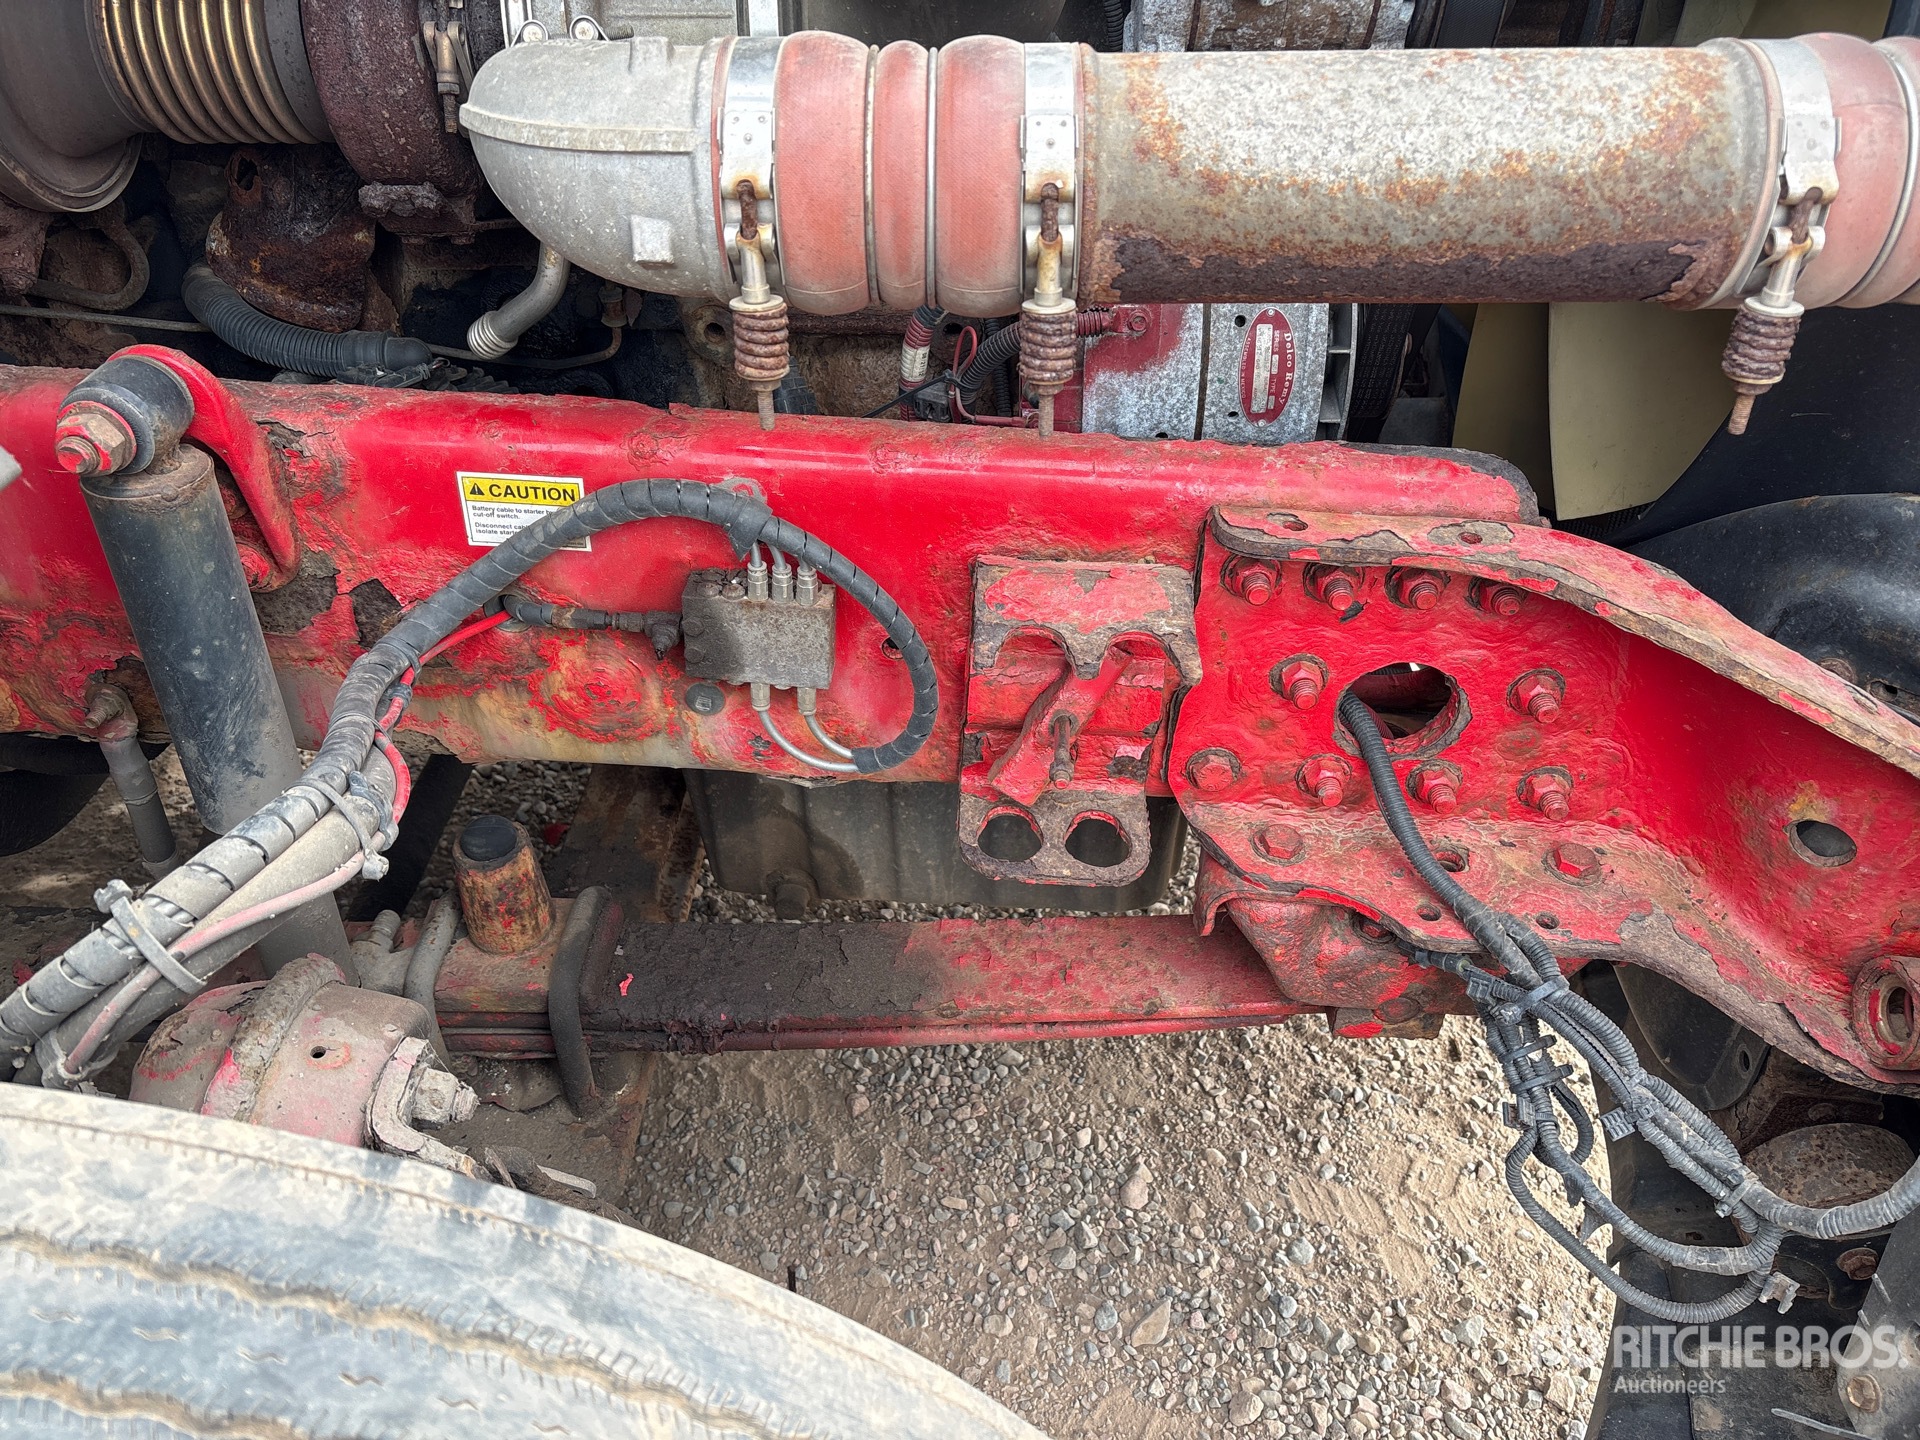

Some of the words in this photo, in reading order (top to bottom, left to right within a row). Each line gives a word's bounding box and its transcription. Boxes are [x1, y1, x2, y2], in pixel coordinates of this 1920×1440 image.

[1241, 337, 1252, 370] ASSEMBLED
[1283, 332, 1293, 368] Delco
[1279, 372, 1293, 405] Remy
[489, 484, 576, 502] CAUTION
[472, 505, 495, 514] Battery
[475, 522, 512, 530] Disconnect
